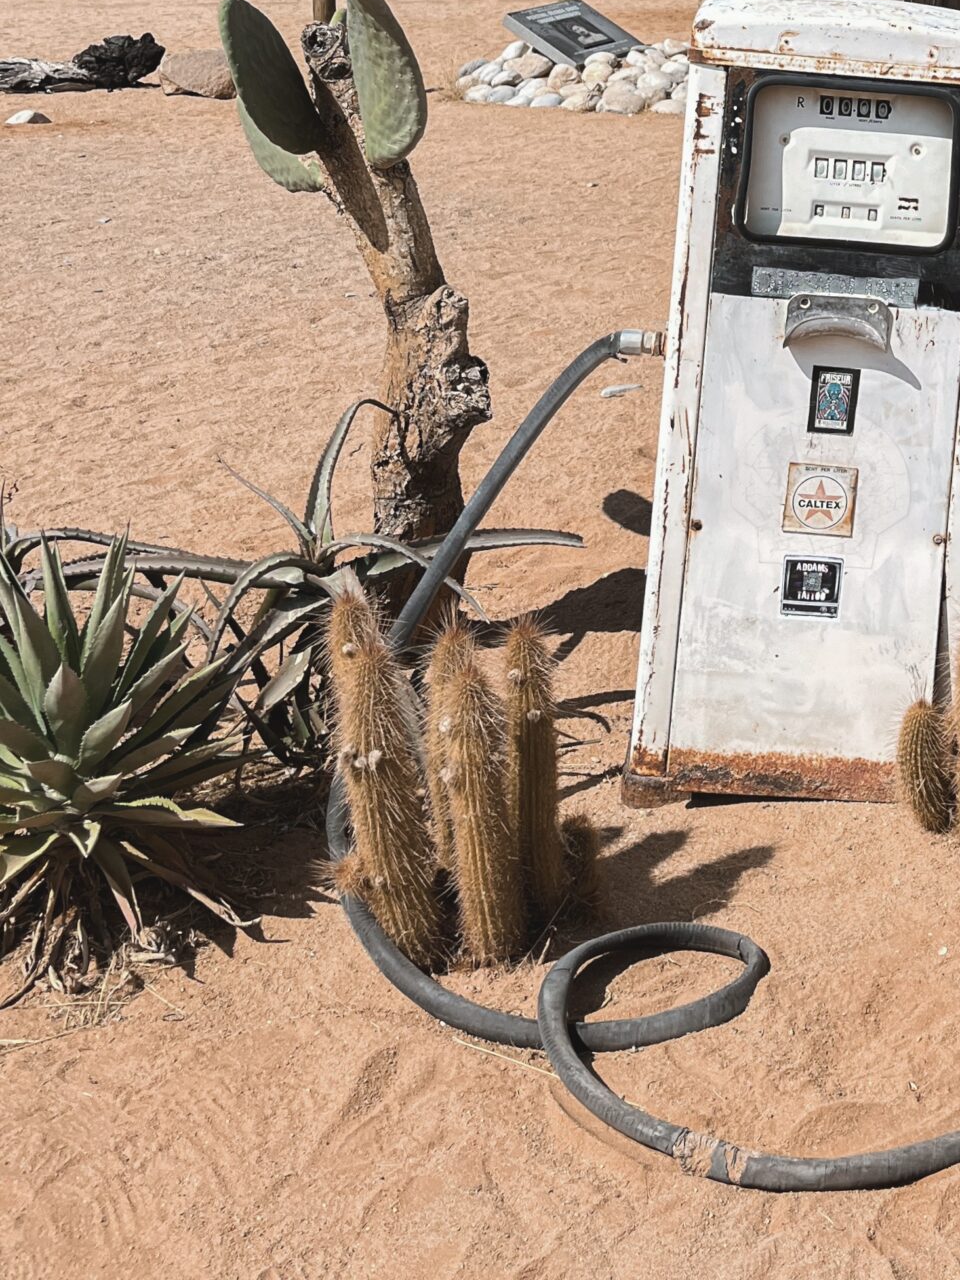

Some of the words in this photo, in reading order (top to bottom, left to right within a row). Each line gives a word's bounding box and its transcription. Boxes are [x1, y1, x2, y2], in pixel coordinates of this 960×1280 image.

[798, 499, 841, 510] CALTEX
[796, 562, 829, 573] ADDAMS
[797, 590, 826, 601] TATTOO
